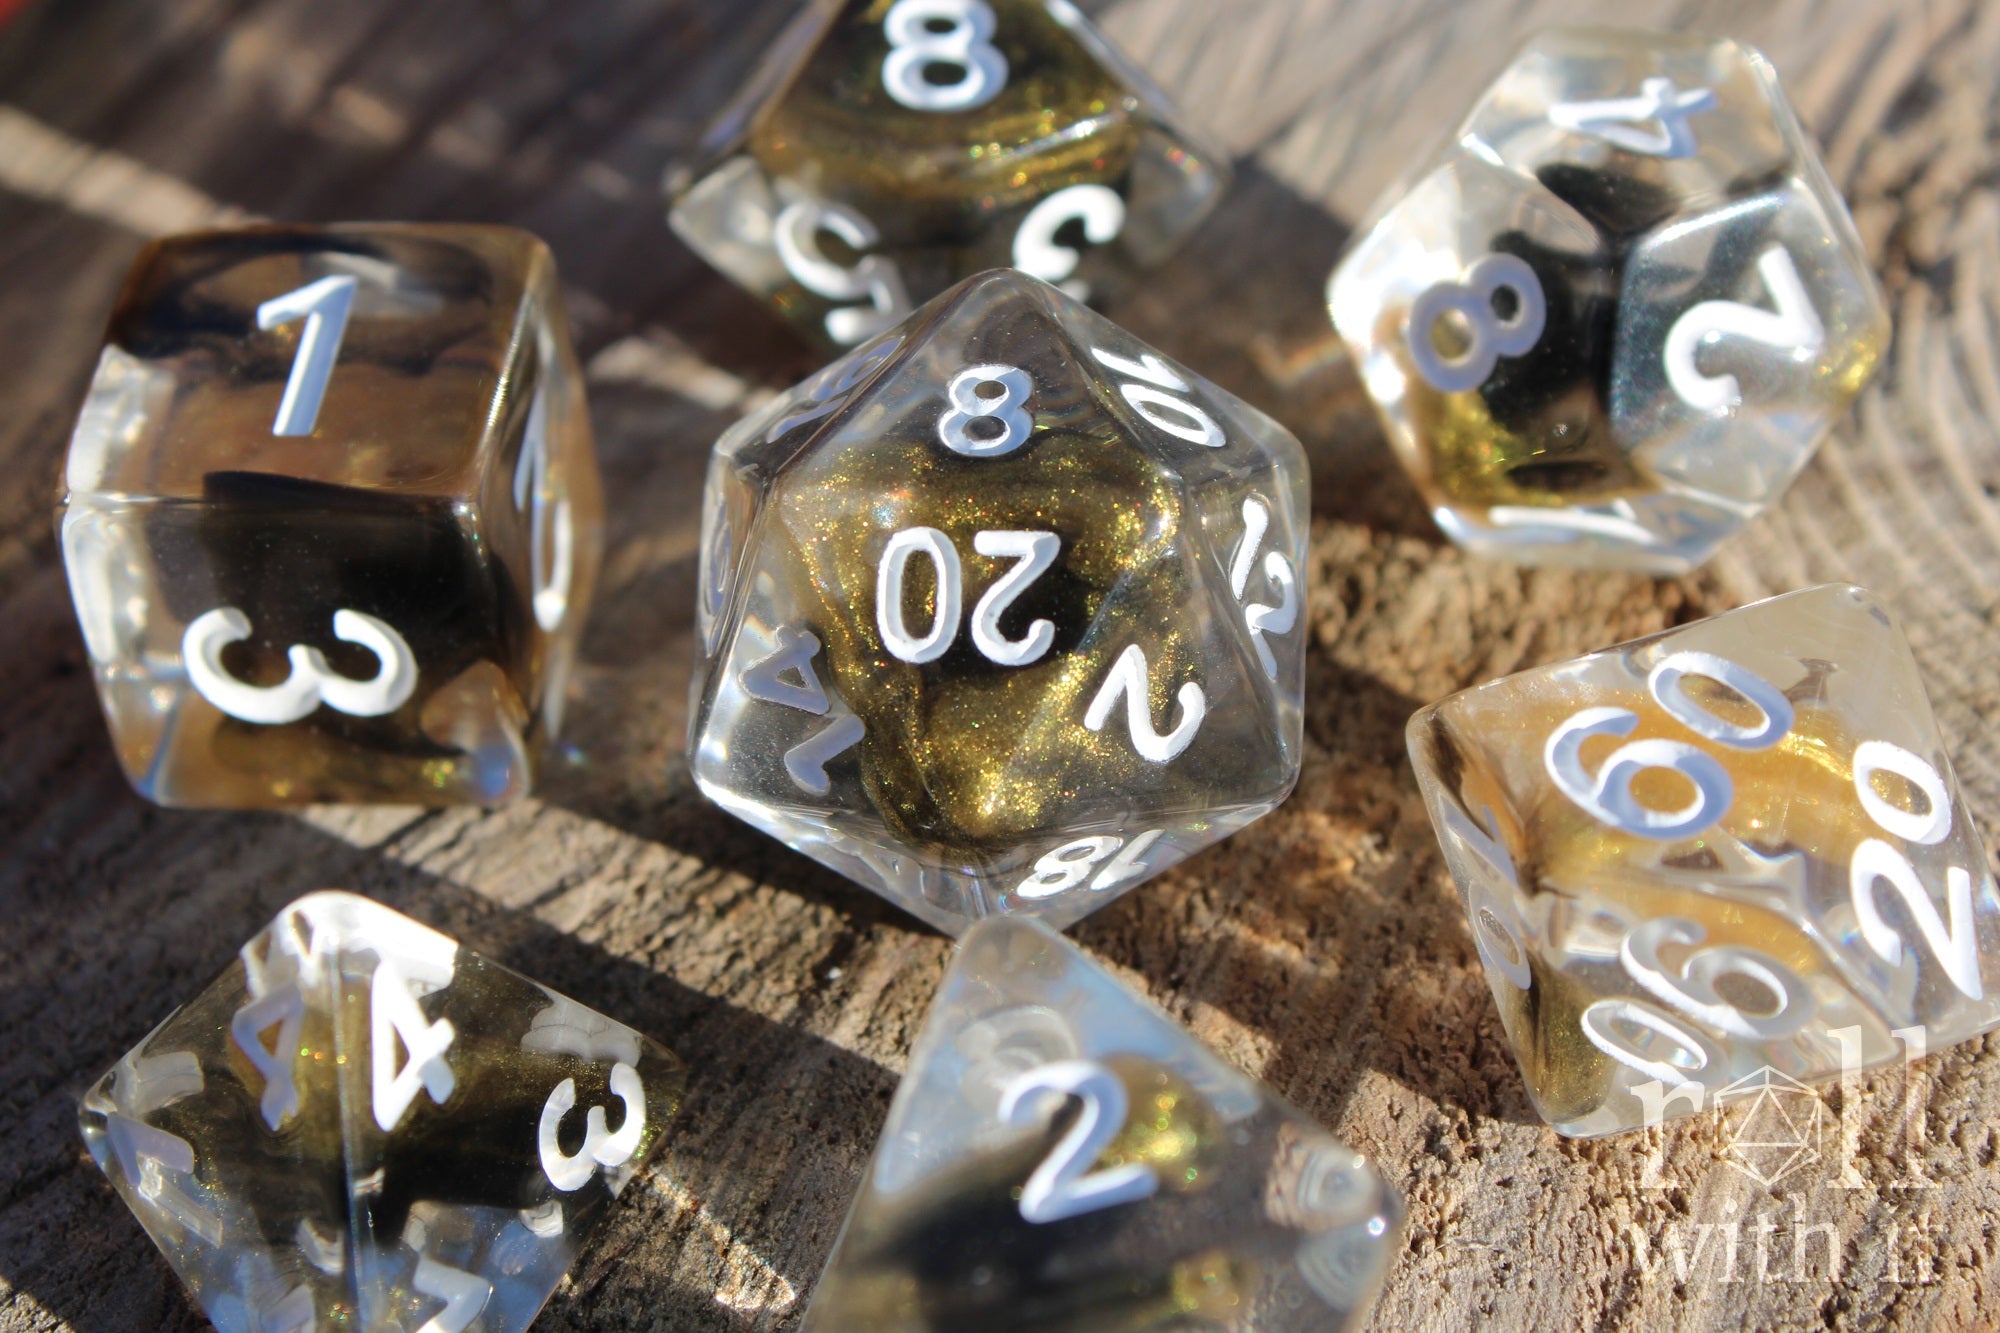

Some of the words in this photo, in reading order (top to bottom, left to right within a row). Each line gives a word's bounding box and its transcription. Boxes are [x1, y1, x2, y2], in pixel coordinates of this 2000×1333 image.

[883, 0, 1009, 112] 8
[1549, 77, 1716, 159] 4
[257, 274, 358, 437] 1
[1410, 252, 1547, 393] 8
[1664, 243, 1824, 413] 2
[938, 364, 1034, 458] 8
[1091, 346, 1228, 448] 10
[876, 526, 1062, 667] 20
[1230, 495, 1298, 681] 12
[182, 606, 419, 725] 3
[738, 624, 866, 796] 14
[1085, 644, 1206, 763] 2
[1545, 651, 1795, 840] 60
[1016, 829, 1165, 898] 18
[1850, 739, 1984, 1002] 20
[538, 1062, 647, 1192] 3
[1000, 1059, 1158, 1225] 2
